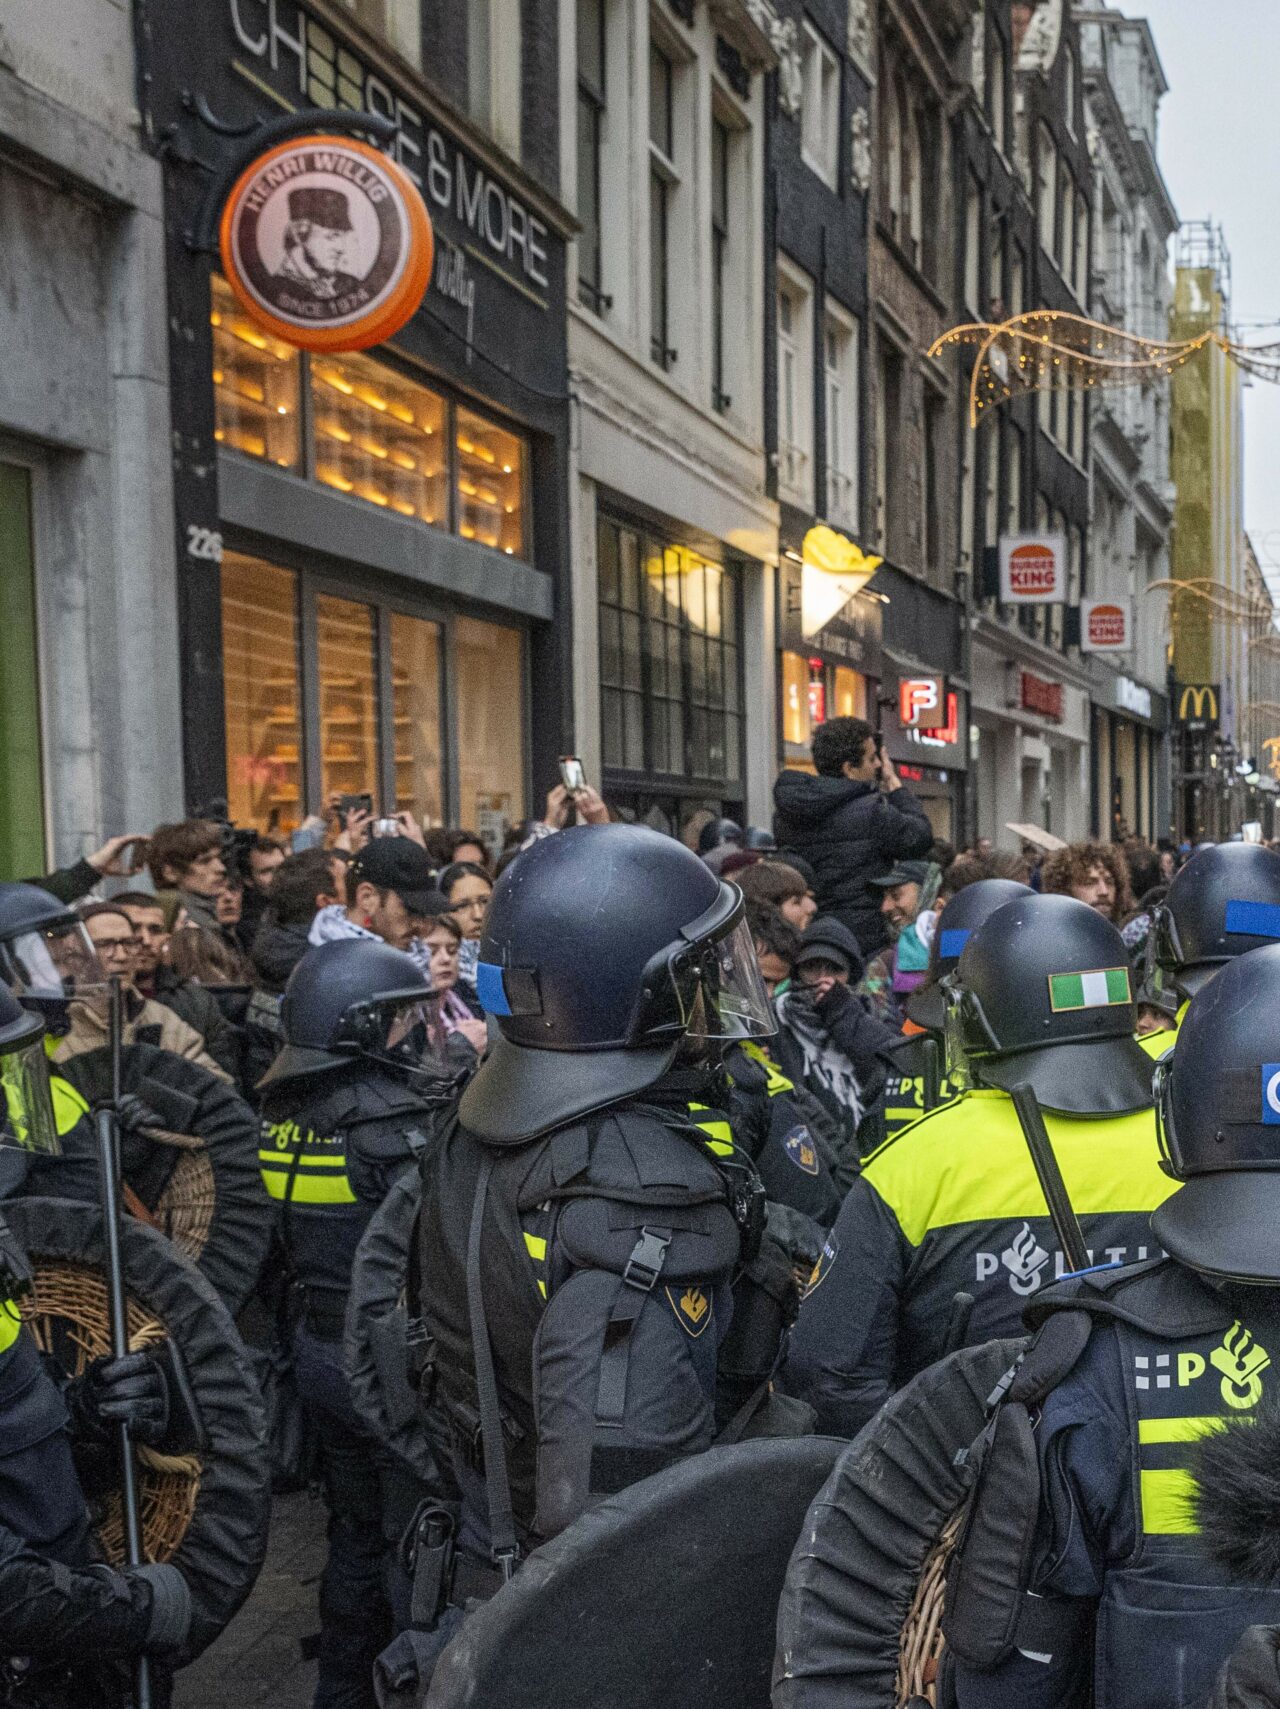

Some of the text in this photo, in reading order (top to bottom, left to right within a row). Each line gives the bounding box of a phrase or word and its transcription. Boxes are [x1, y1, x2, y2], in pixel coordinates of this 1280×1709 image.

[246, 152, 388, 213] HENRI WILLIG
[427, 128, 451, 208] &
[456, 151, 549, 288] MORE
[276, 293, 322, 316] SINCE
[1010, 560, 1054, 570] BURGER
[1010, 572, 1055, 584] KING
[1089, 626, 1125, 637] KING
